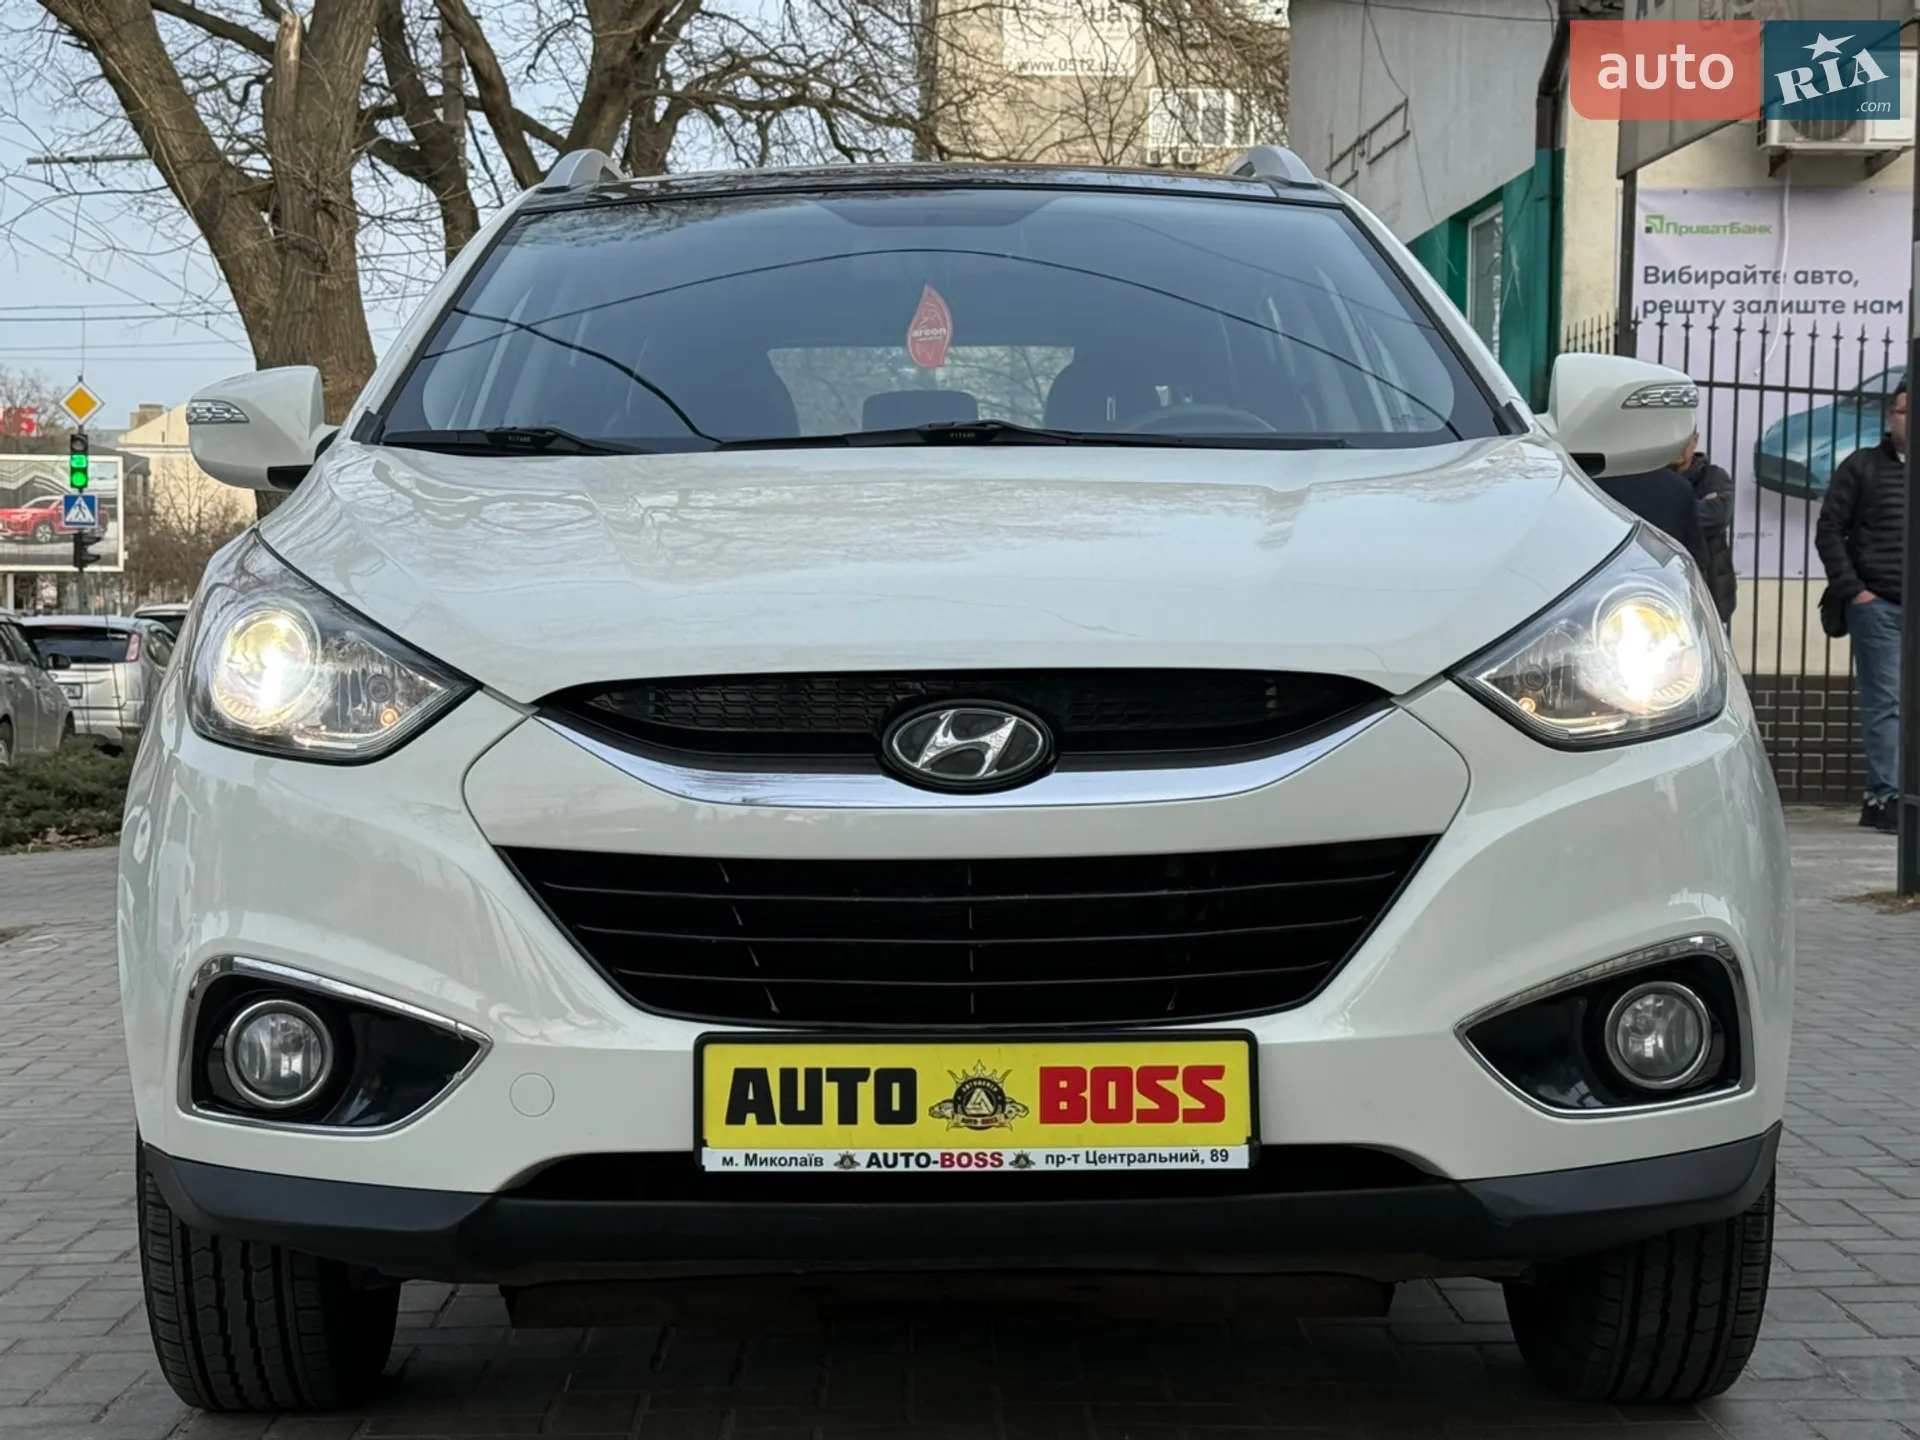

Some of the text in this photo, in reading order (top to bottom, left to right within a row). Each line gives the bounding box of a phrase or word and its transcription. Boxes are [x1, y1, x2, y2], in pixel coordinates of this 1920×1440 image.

[1665, 222, 1772, 236] ПриватБанк
[1643, 264, 1859, 289] Вибирайте авто,
[1642, 299, 1904, 319] решту залиште нам
[725, 1065, 1226, 1125] AUTO BOSS
[721, 1149, 1229, 1169] м. Миколаїв AUTO-BOSS пр-т Центральний, 89
